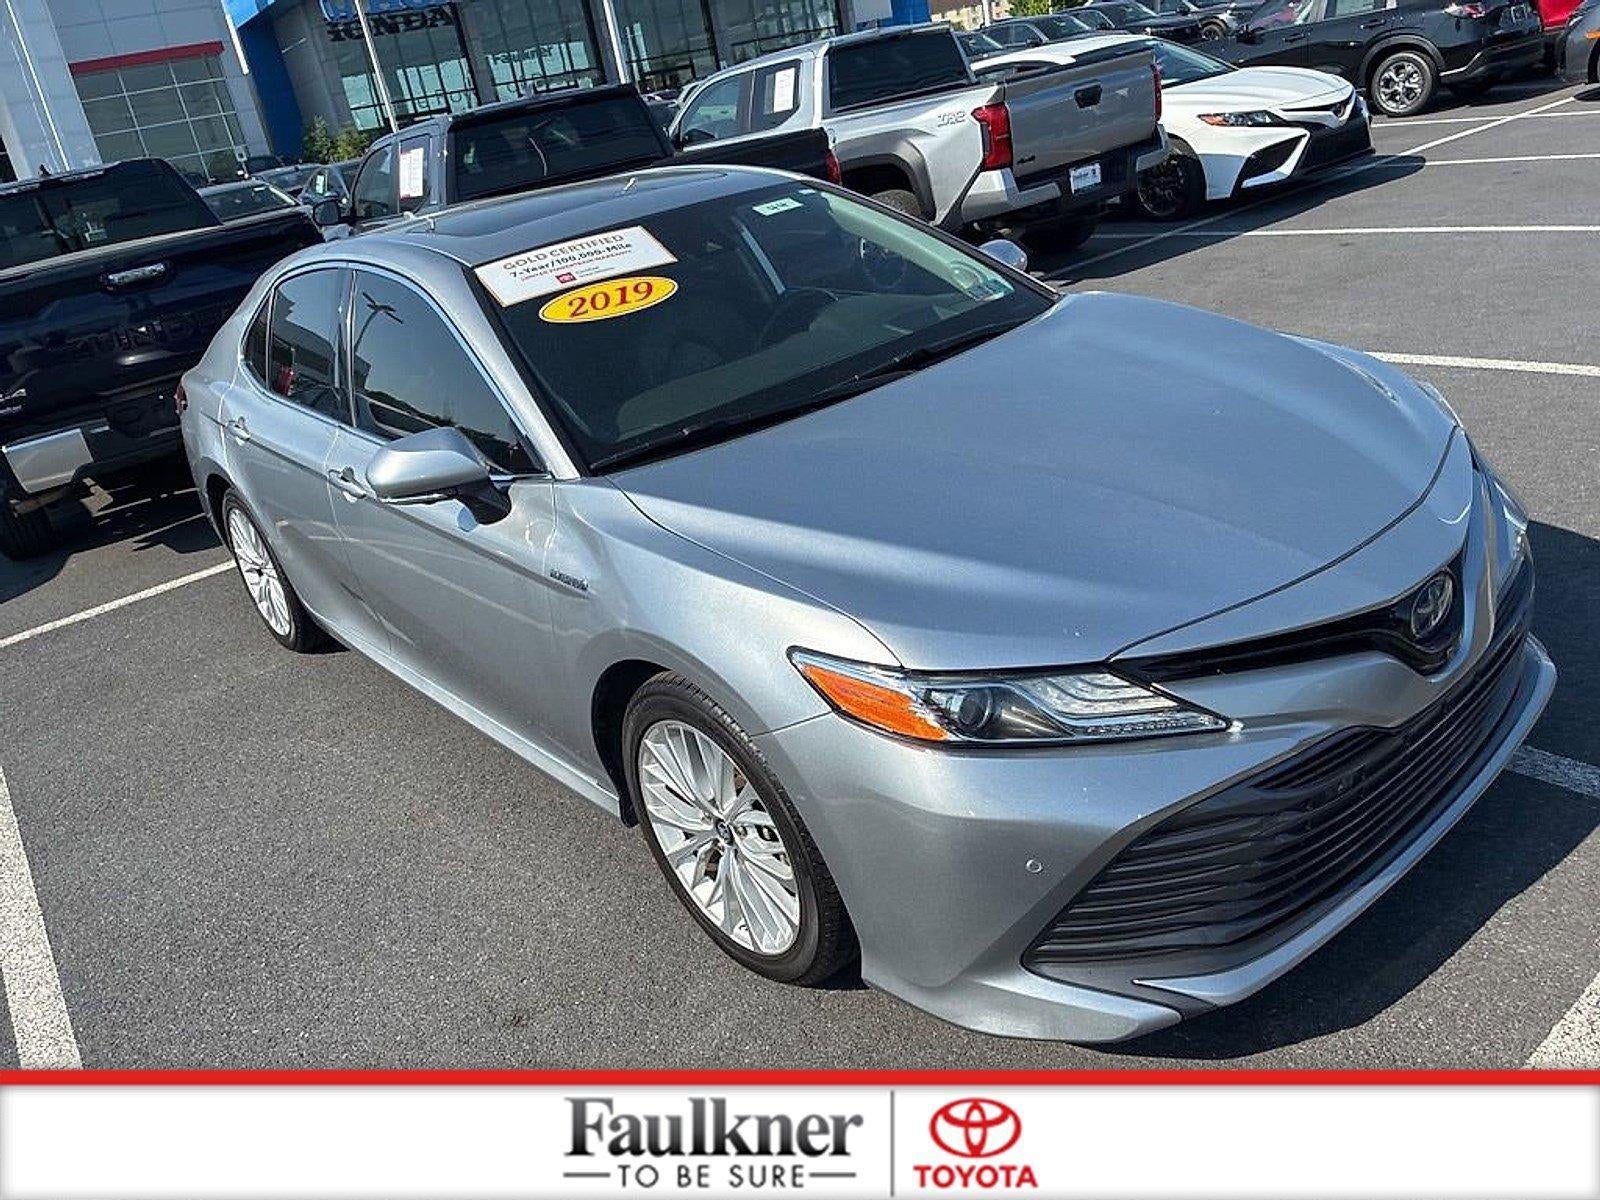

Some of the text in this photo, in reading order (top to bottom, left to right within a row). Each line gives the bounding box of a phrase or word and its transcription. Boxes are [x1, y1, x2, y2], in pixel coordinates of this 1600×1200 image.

[503, 252, 548, 271] GOLD
[549, 234, 624, 257] CERTIFIED
[568, 280, 654, 319] 2019
